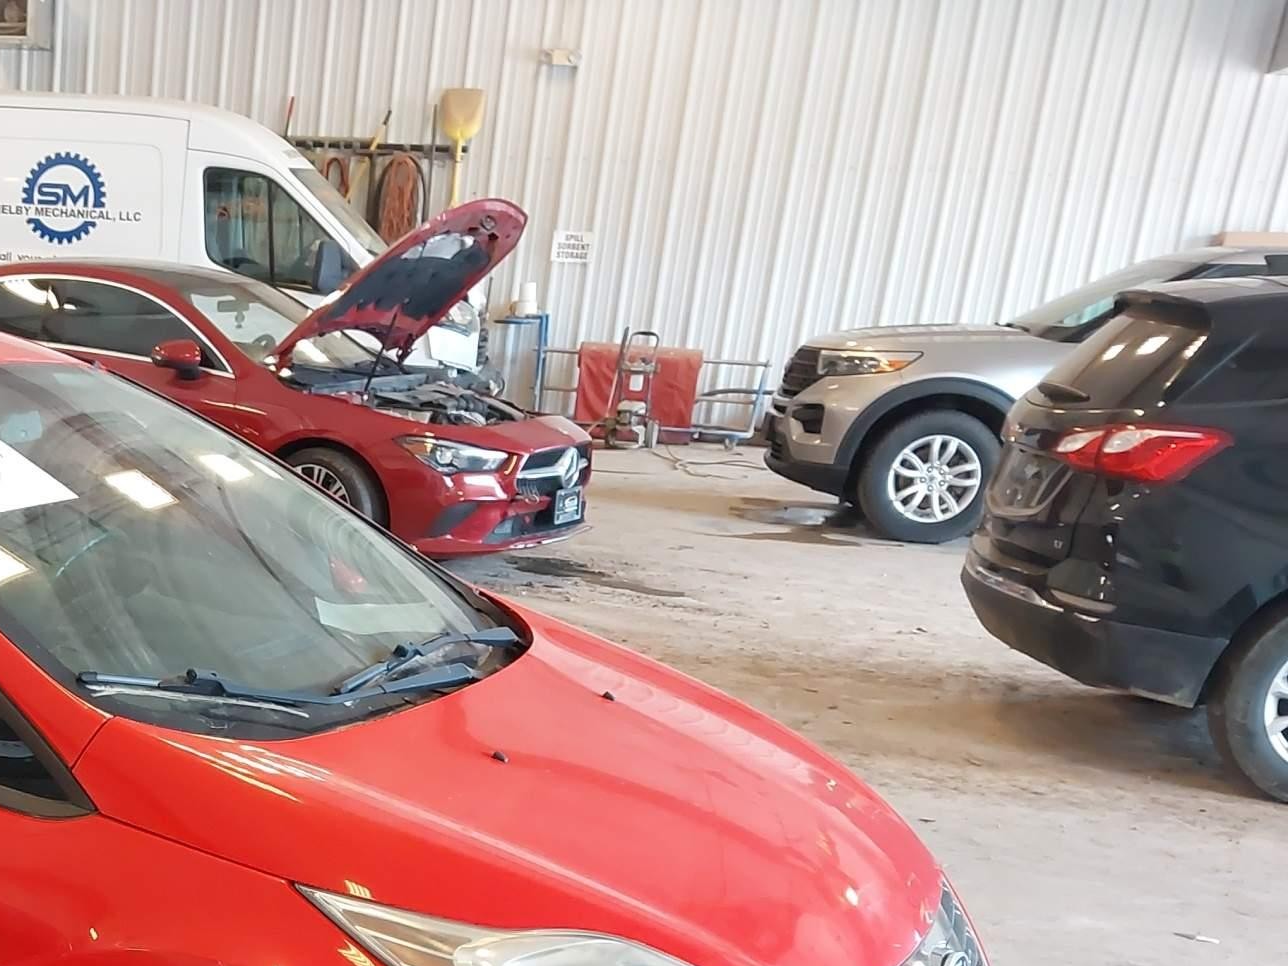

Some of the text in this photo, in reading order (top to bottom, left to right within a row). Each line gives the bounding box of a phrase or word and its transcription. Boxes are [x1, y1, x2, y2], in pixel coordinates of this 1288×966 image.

[37, 182, 90, 208] SM
[34, 207, 116, 222] MECHANICAL,
[119, 211, 142, 222] LLC
[0, 251, 12, 261] all
